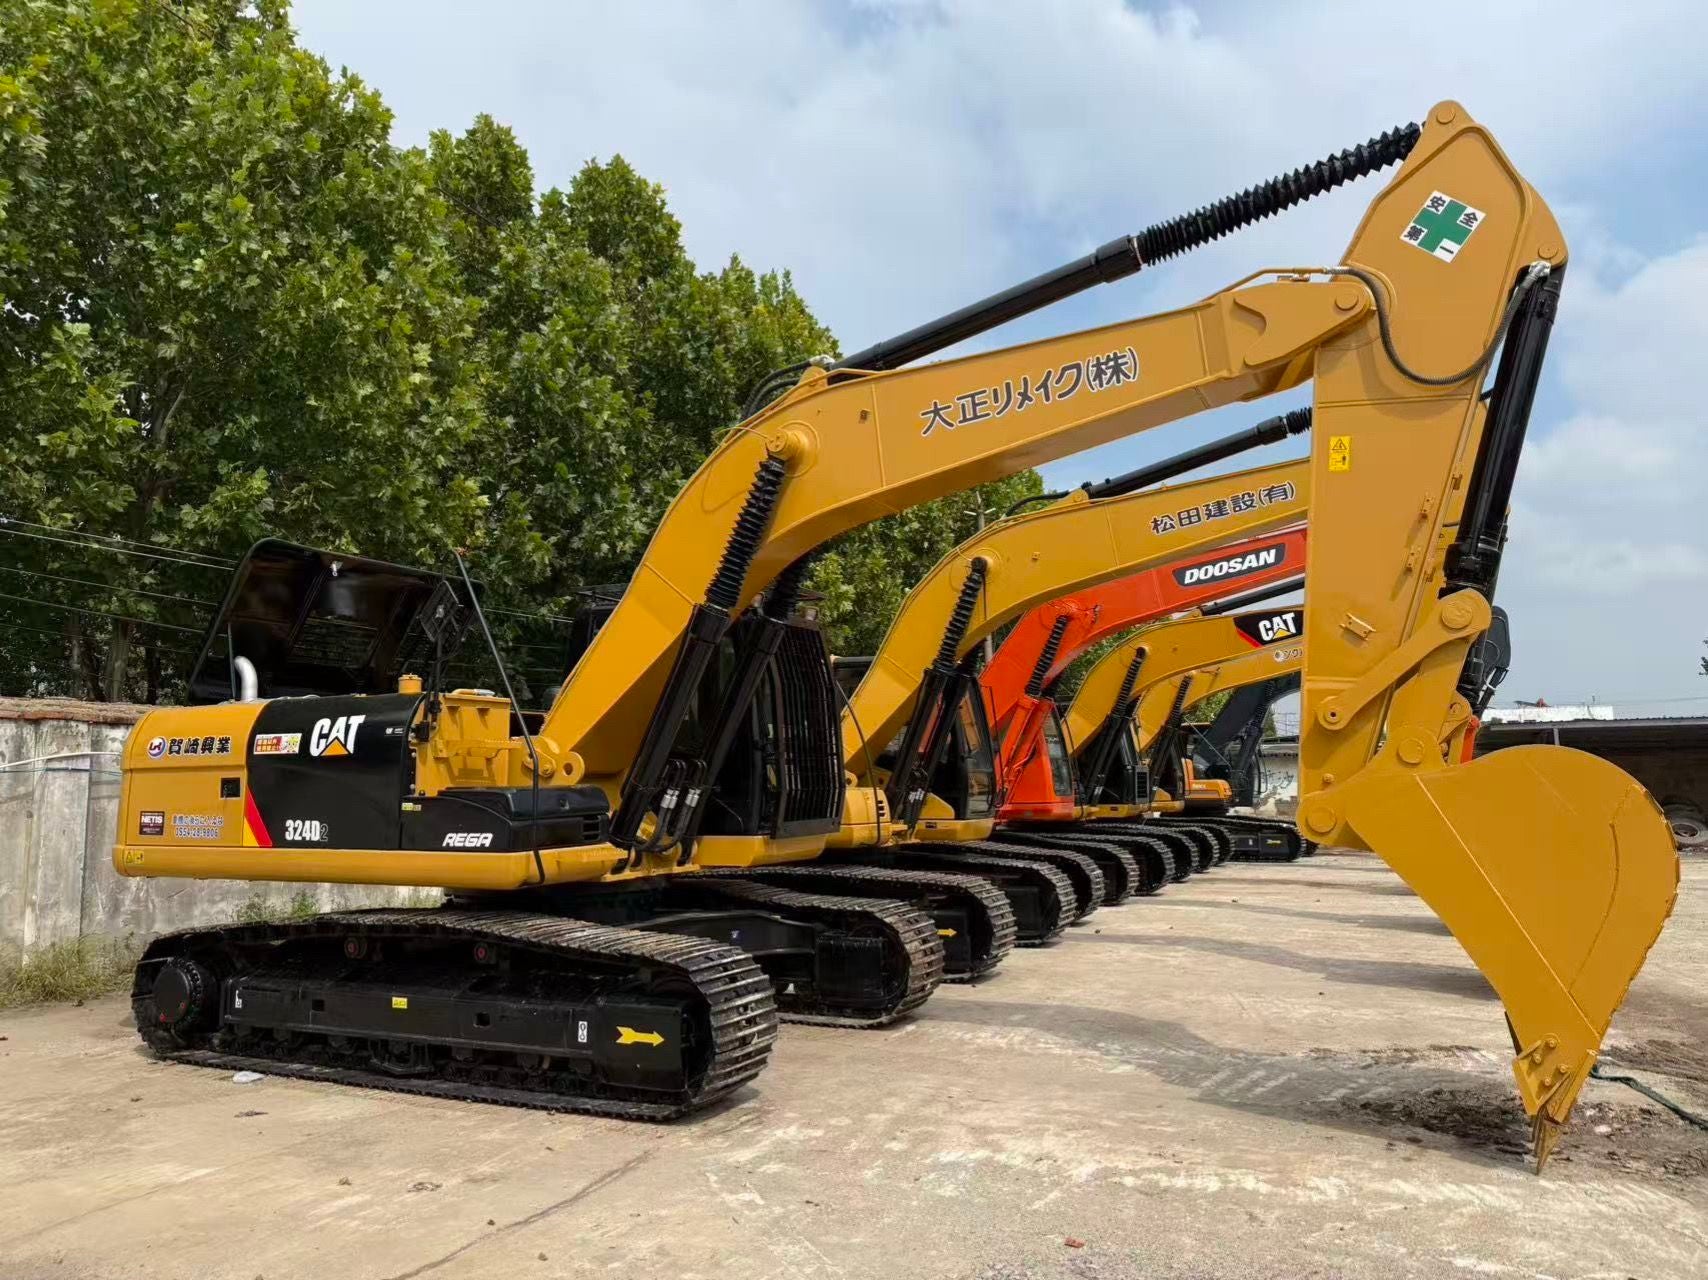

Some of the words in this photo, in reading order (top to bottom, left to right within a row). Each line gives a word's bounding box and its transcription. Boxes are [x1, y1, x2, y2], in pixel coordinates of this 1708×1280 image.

[920, 346, 1139, 436] 大正リメイク(株)
[1150, 481, 1296, 535] 松田建設(有)
[1184, 549, 1277, 585] DOOSAN
[1258, 612, 1297, 642] CAT
[309, 714, 367, 758] CAT
[141, 815, 163, 824] NETIS
[285, 819, 329, 842] 324D2
[442, 832, 493, 848] REGA
